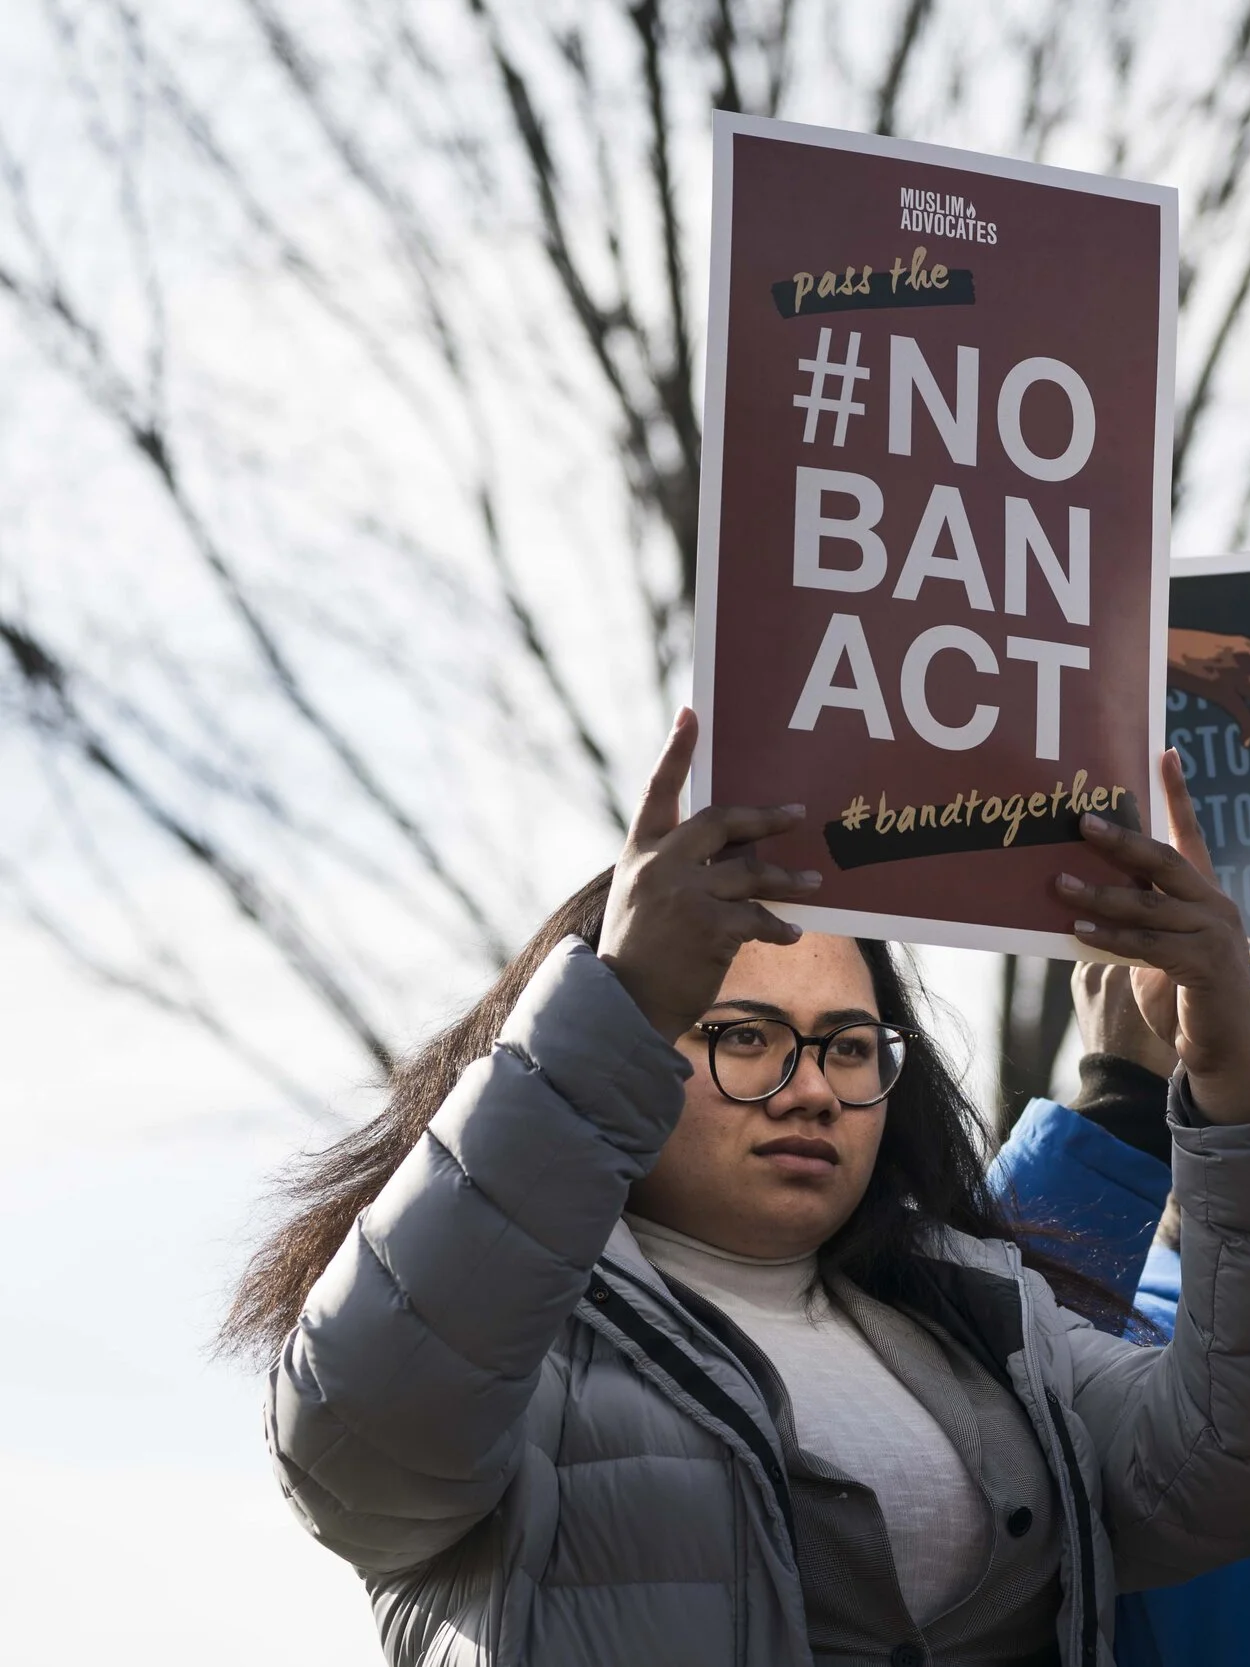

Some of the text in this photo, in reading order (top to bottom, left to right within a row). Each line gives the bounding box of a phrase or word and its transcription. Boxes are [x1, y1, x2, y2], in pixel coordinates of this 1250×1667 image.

[900, 187, 964, 217] MUSLIM
[900, 208, 998, 245] ADVOCATES
[793, 246, 950, 313] pass the
[793, 327, 1096, 482] #NO
[792, 465, 1090, 626] BAN
[787, 612, 1090, 760] ACT
[841, 769, 1126, 847] #bandtogether
